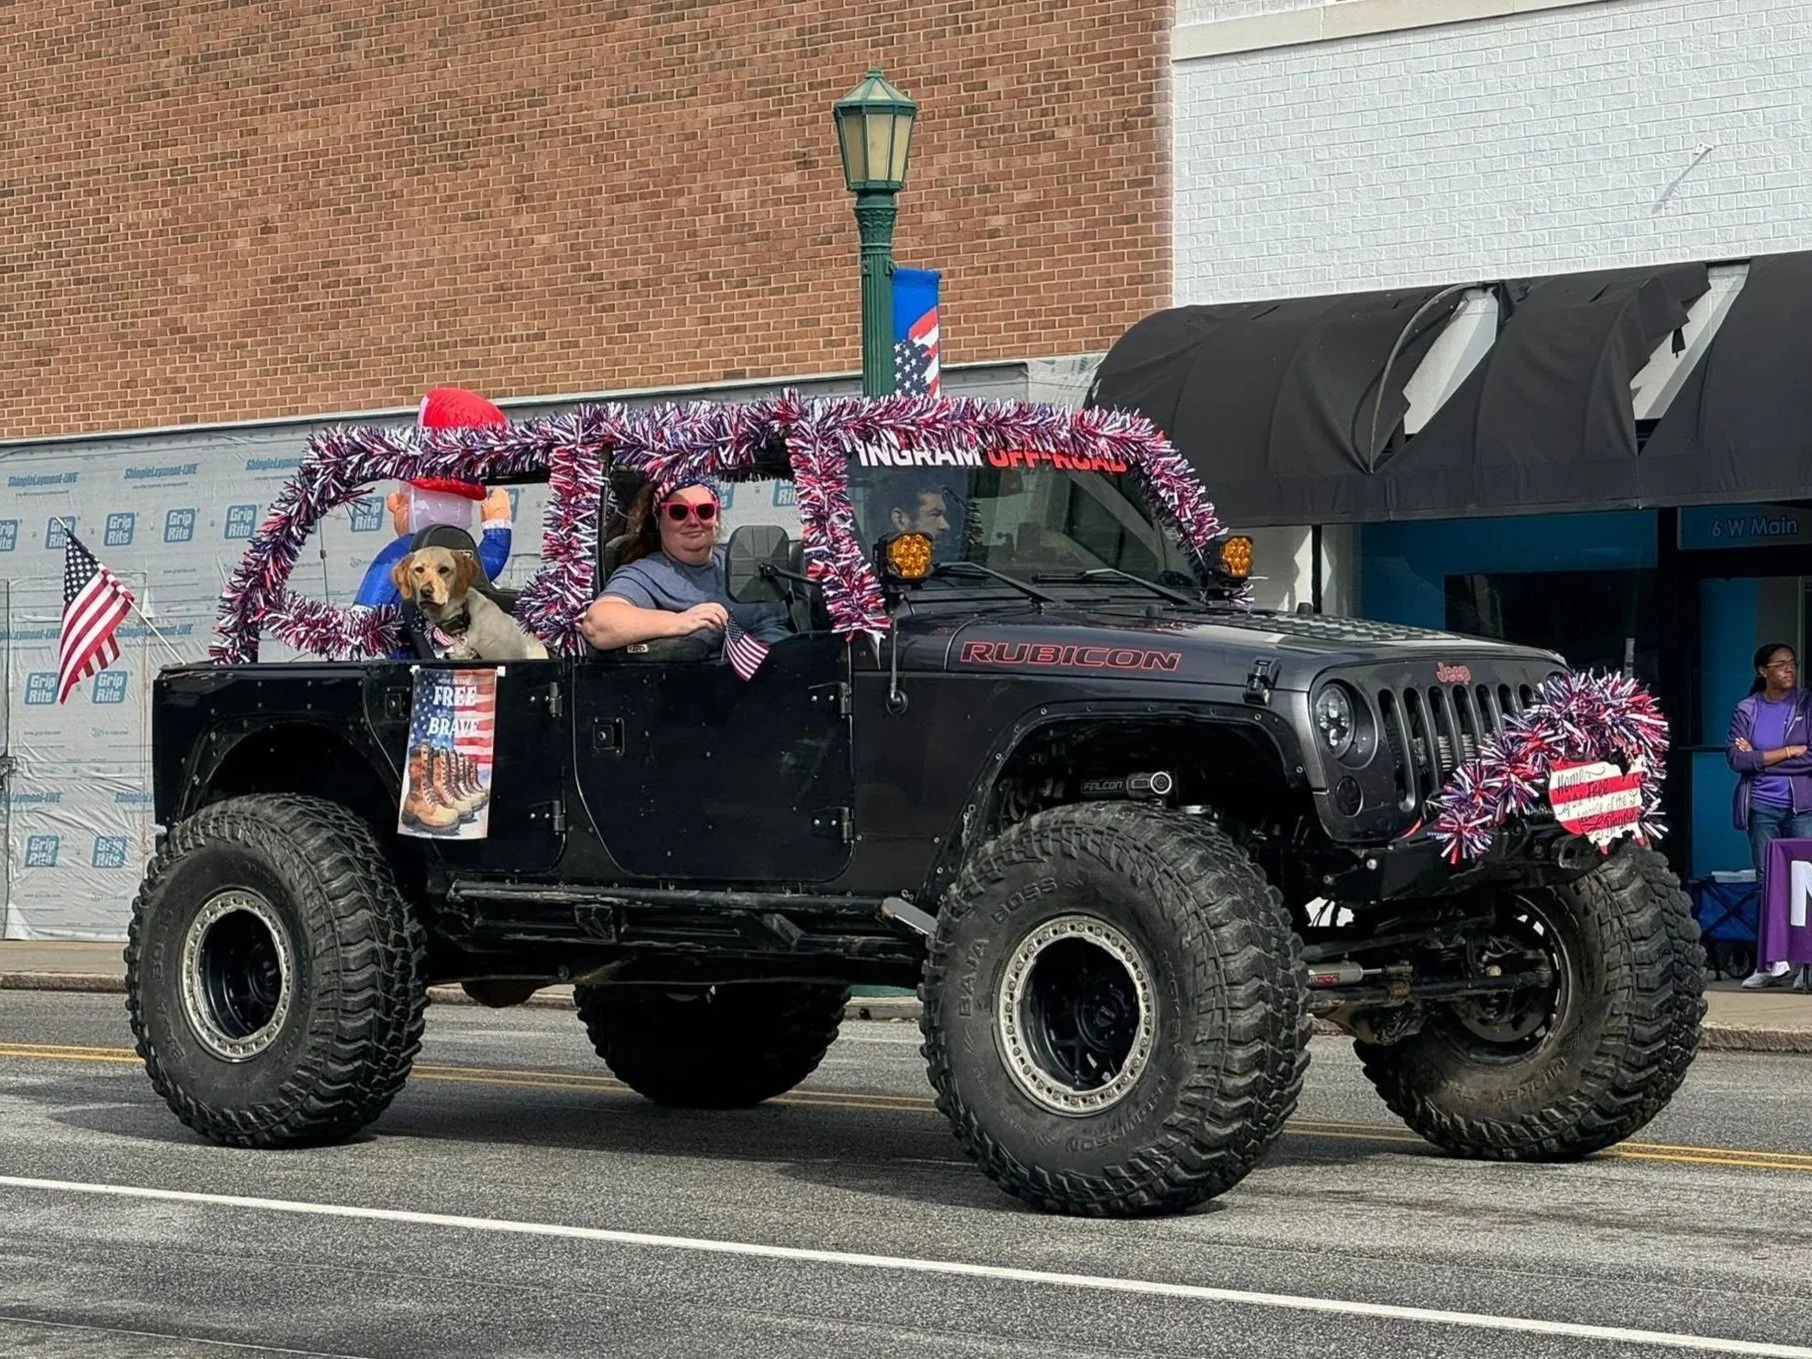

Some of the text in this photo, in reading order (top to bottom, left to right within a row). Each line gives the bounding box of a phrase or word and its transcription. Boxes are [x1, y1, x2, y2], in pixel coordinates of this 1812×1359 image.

[858, 440, 983, 467] INGRAM
[109, 516, 132, 530] Grip
[169, 511, 193, 526] Grip
[230, 507, 253, 523] Grip
[0, 521, 15, 537] rip
[167, 526, 190, 540] Rite
[228, 522, 251, 537] Rite
[1711, 516, 1798, 537] 6 W Main
[107, 530, 129, 544] Rite
[960, 641, 1182, 672] RUBICON
[30, 674, 56, 689] Grip
[98, 672, 124, 689] Grip
[1436, 662, 1472, 686] Jeep
[28, 688, 53, 703] Rite
[95, 688, 120, 702] Rite
[432, 685, 478, 707] FREE
[426, 716, 480, 738] BRAVE
[958, 876, 1058, 1018] BAJA BOSS
